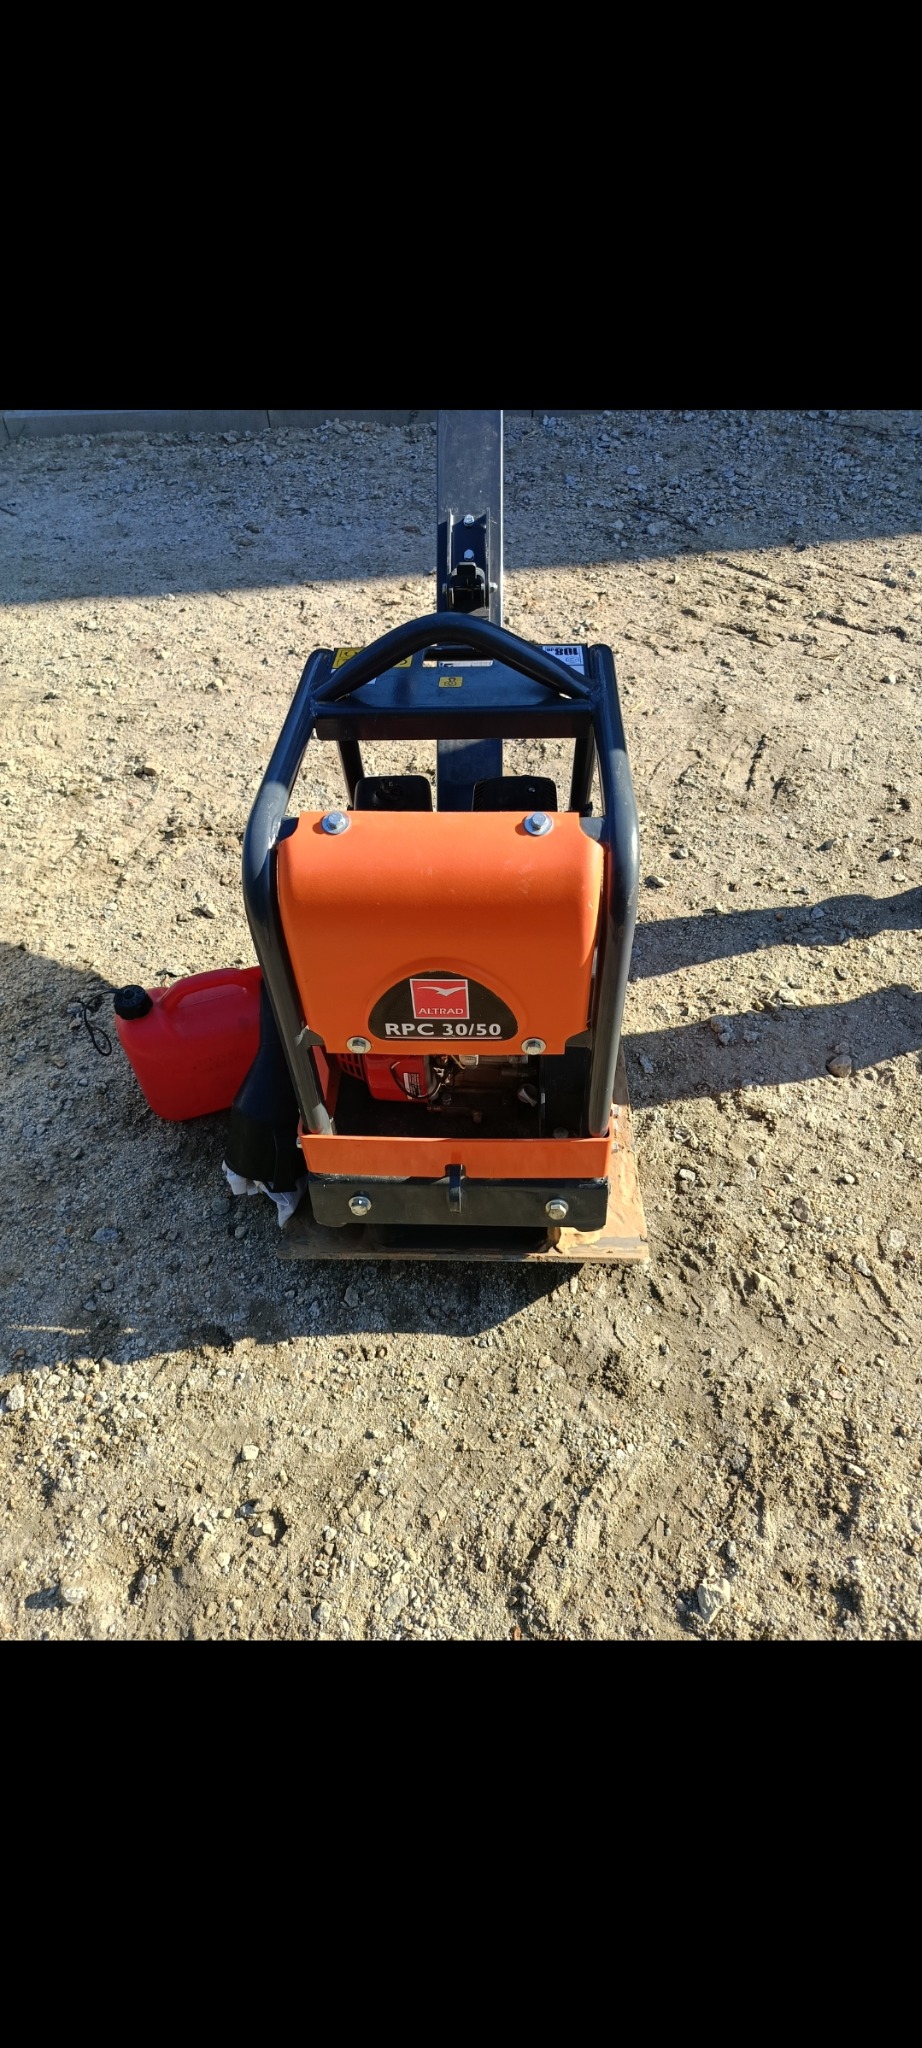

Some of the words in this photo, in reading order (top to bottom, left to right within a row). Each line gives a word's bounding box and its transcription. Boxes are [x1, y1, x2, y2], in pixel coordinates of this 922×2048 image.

[418, 1007, 464, 1015] ALTRAD
[384, 1023, 434, 1036] RPC
[442, 1023, 502, 1036] 30/50
